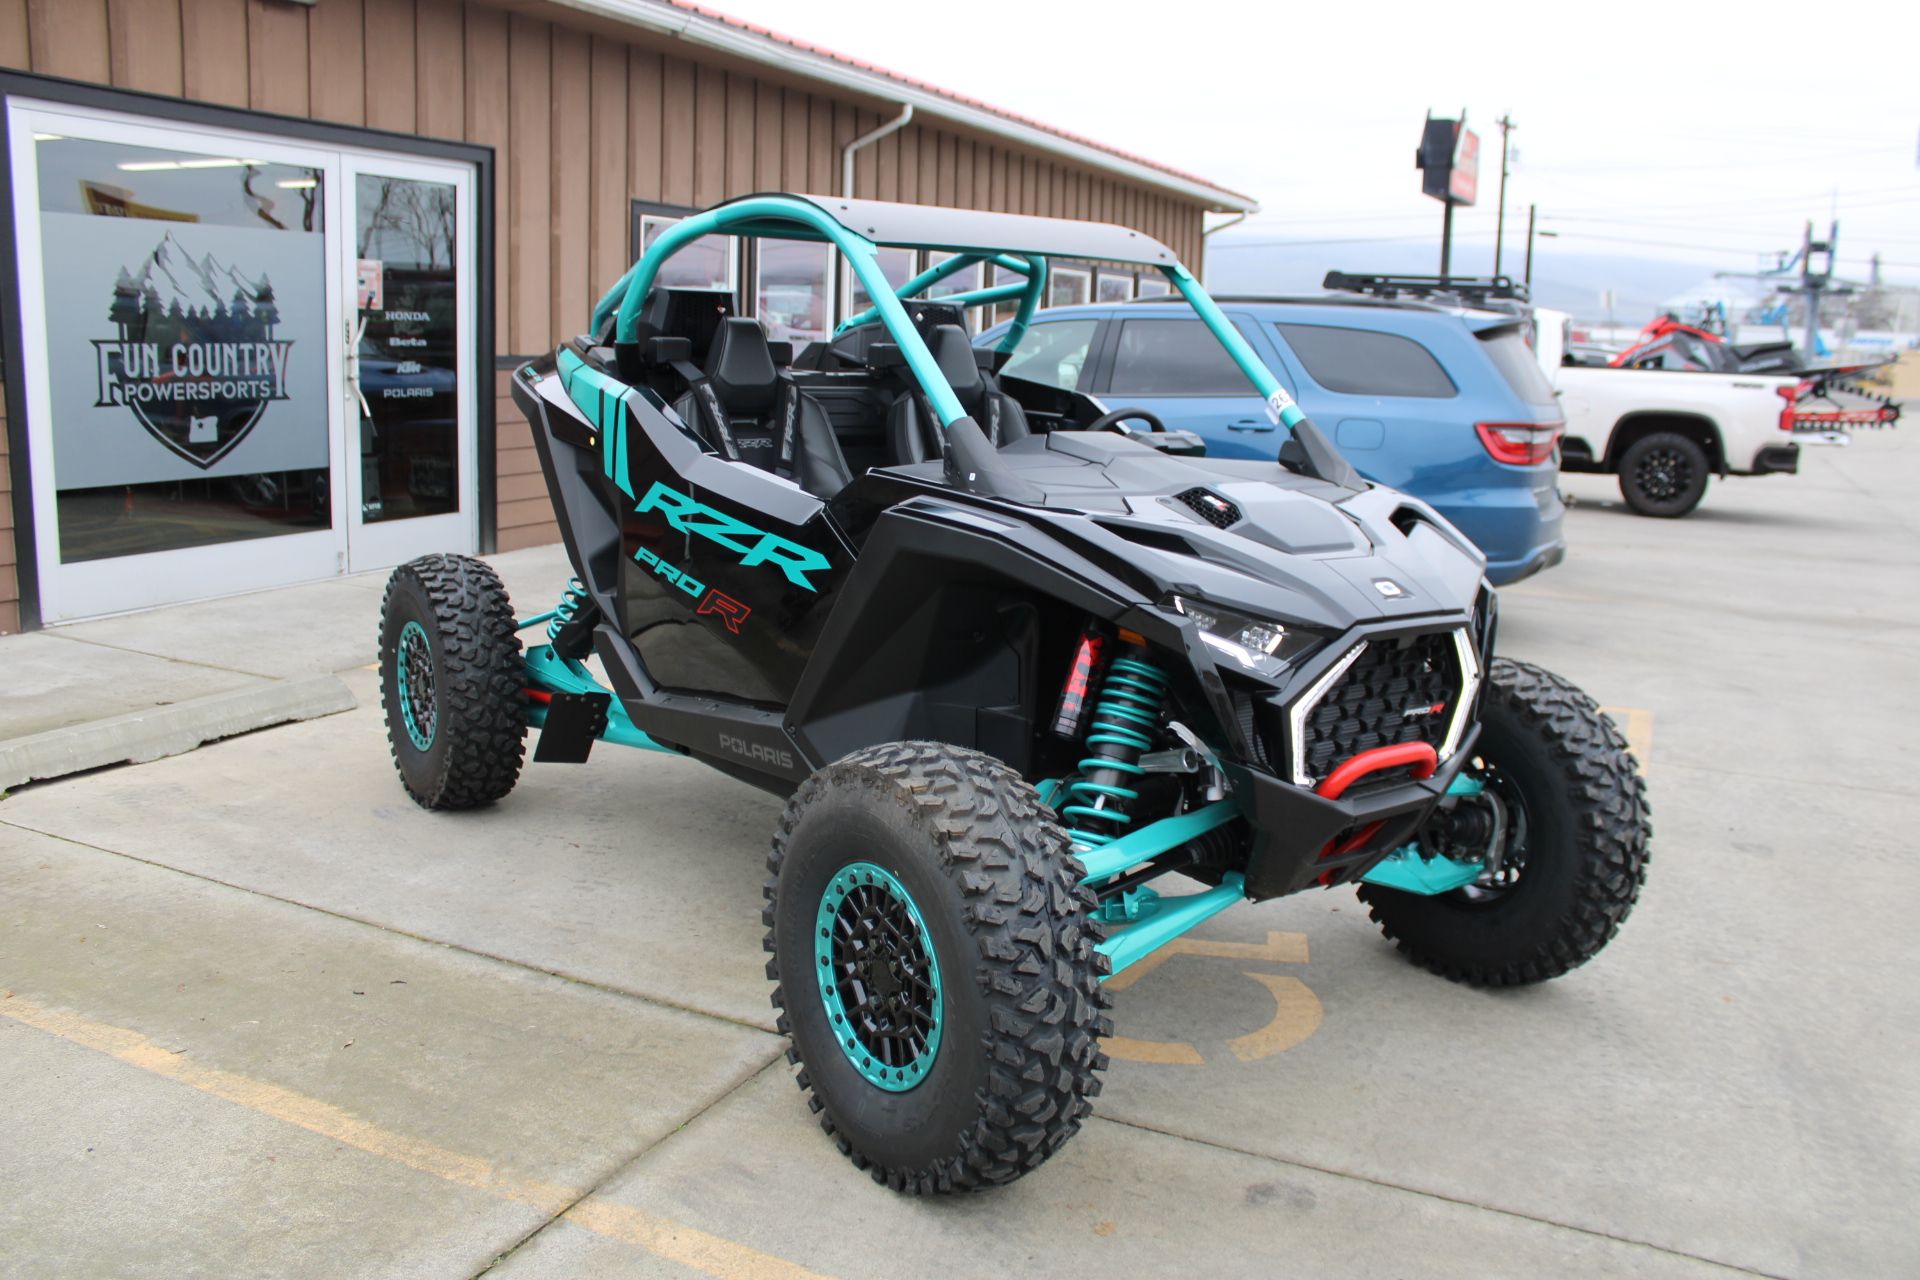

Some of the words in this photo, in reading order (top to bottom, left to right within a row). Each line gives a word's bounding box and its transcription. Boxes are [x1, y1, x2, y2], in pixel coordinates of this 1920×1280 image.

[385, 311, 430, 322] HONDA
[98, 343, 160, 404] FUN
[172, 342, 288, 398] COUNTRY
[124, 380, 271, 403] POWERSPORTS
[384, 388, 434, 399] POLARIS
[634, 480, 832, 593] RZR
[634, 546, 706, 598] PRO
[697, 588, 752, 635] R
[719, 733, 794, 769] POLARIS
